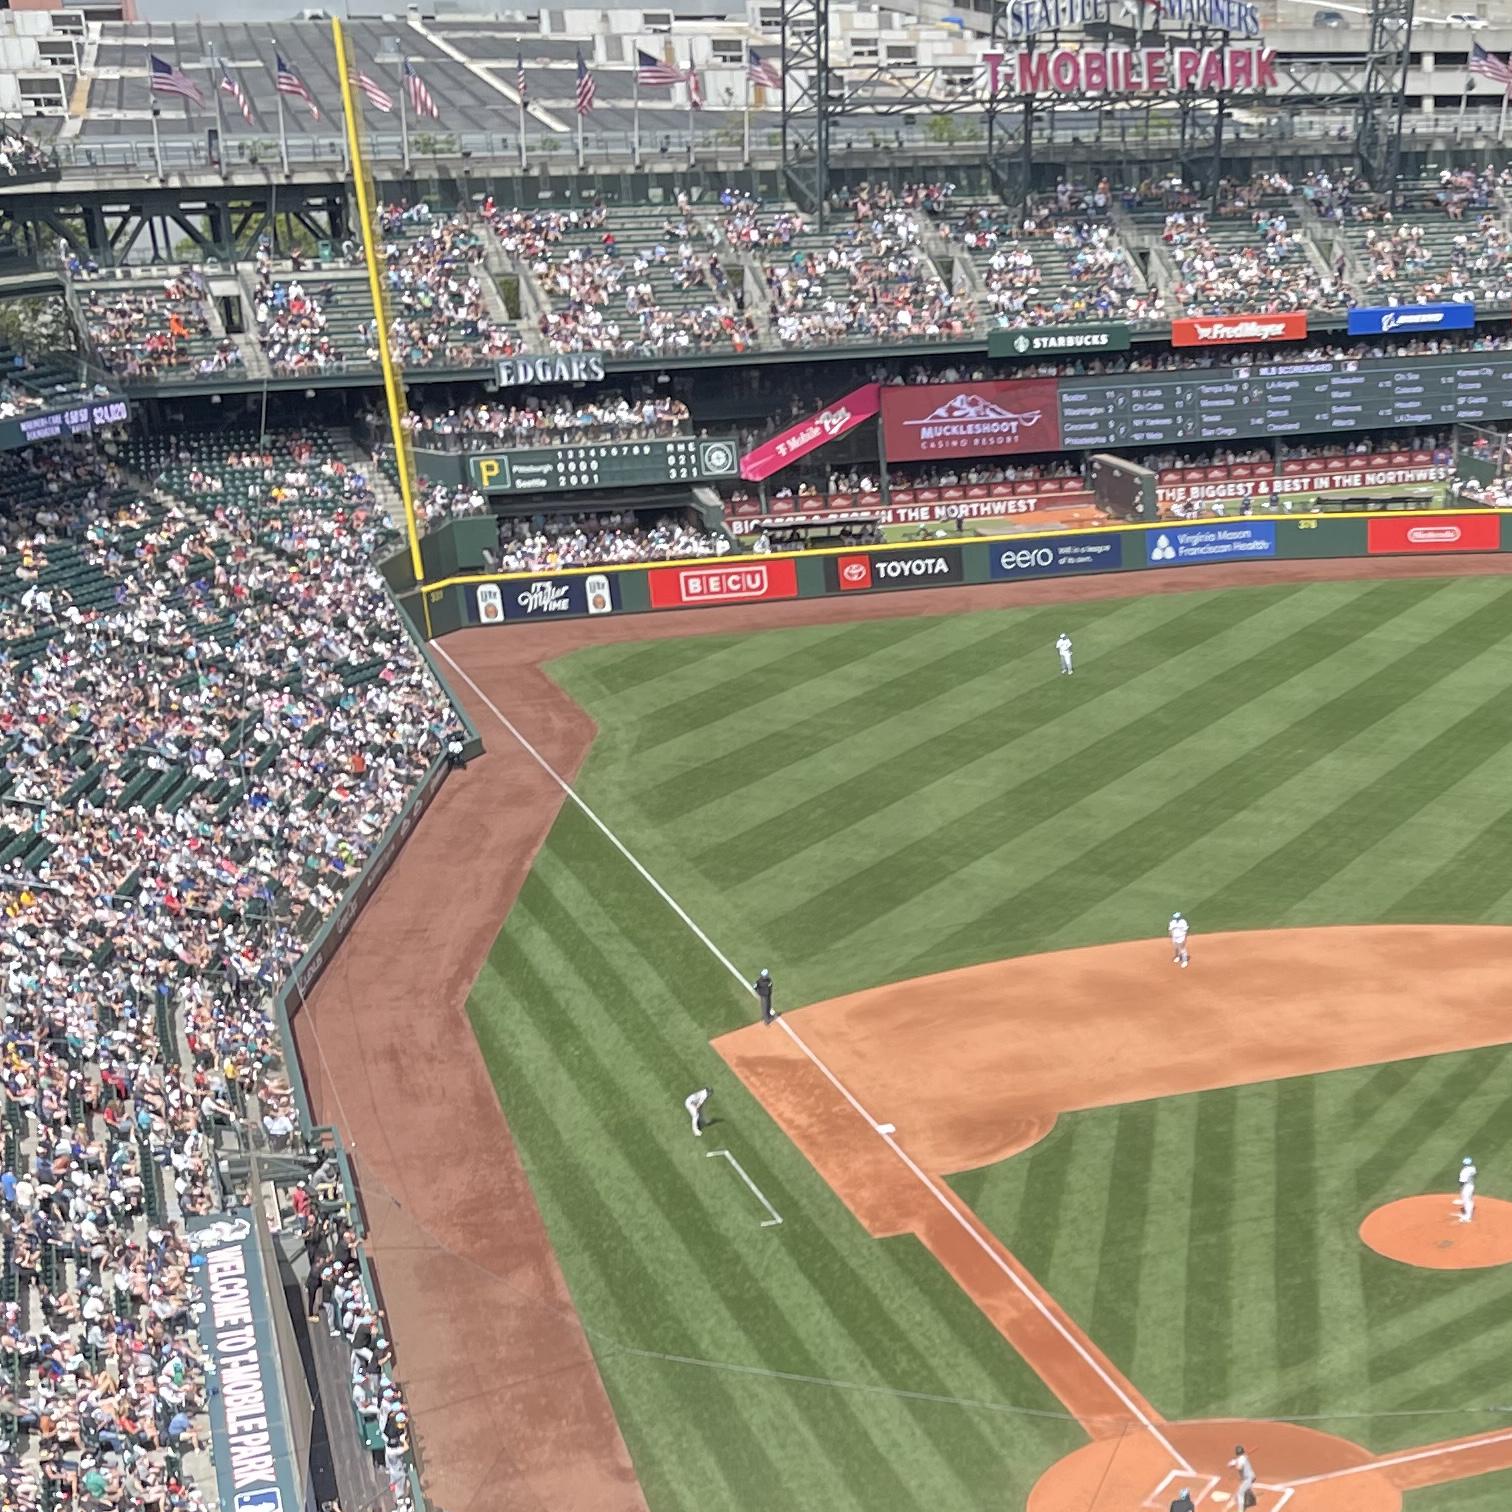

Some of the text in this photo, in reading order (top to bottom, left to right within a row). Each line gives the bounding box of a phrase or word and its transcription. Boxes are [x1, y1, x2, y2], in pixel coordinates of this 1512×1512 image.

[981, 46, 1279, 95] T-MOBILE PARK
[1032, 333, 1109, 349] STARBUCKS
[920, 420, 1019, 441] MUCKLESHOOT
[480, 459, 499, 488] P
[1156, 487, 1187, 501] THE
[1190, 482, 1255, 498] BIGGEST
[1258, 481, 1270, 495] &
[1273, 478, 1311, 493] BEST
[1314, 477, 1330, 490] IN
[1333, 474, 1362, 488] THE
[896, 506, 931, 522] THE
[934, 499, 1037, 519] NORTHWEST
[875, 556, 950, 579] TOYOTA
[1000, 548, 1054, 570] eero
[518, 585, 570, 613] Miller
[206, 1244, 277, 1489] WELCOME TO T-MOBILE PARK
